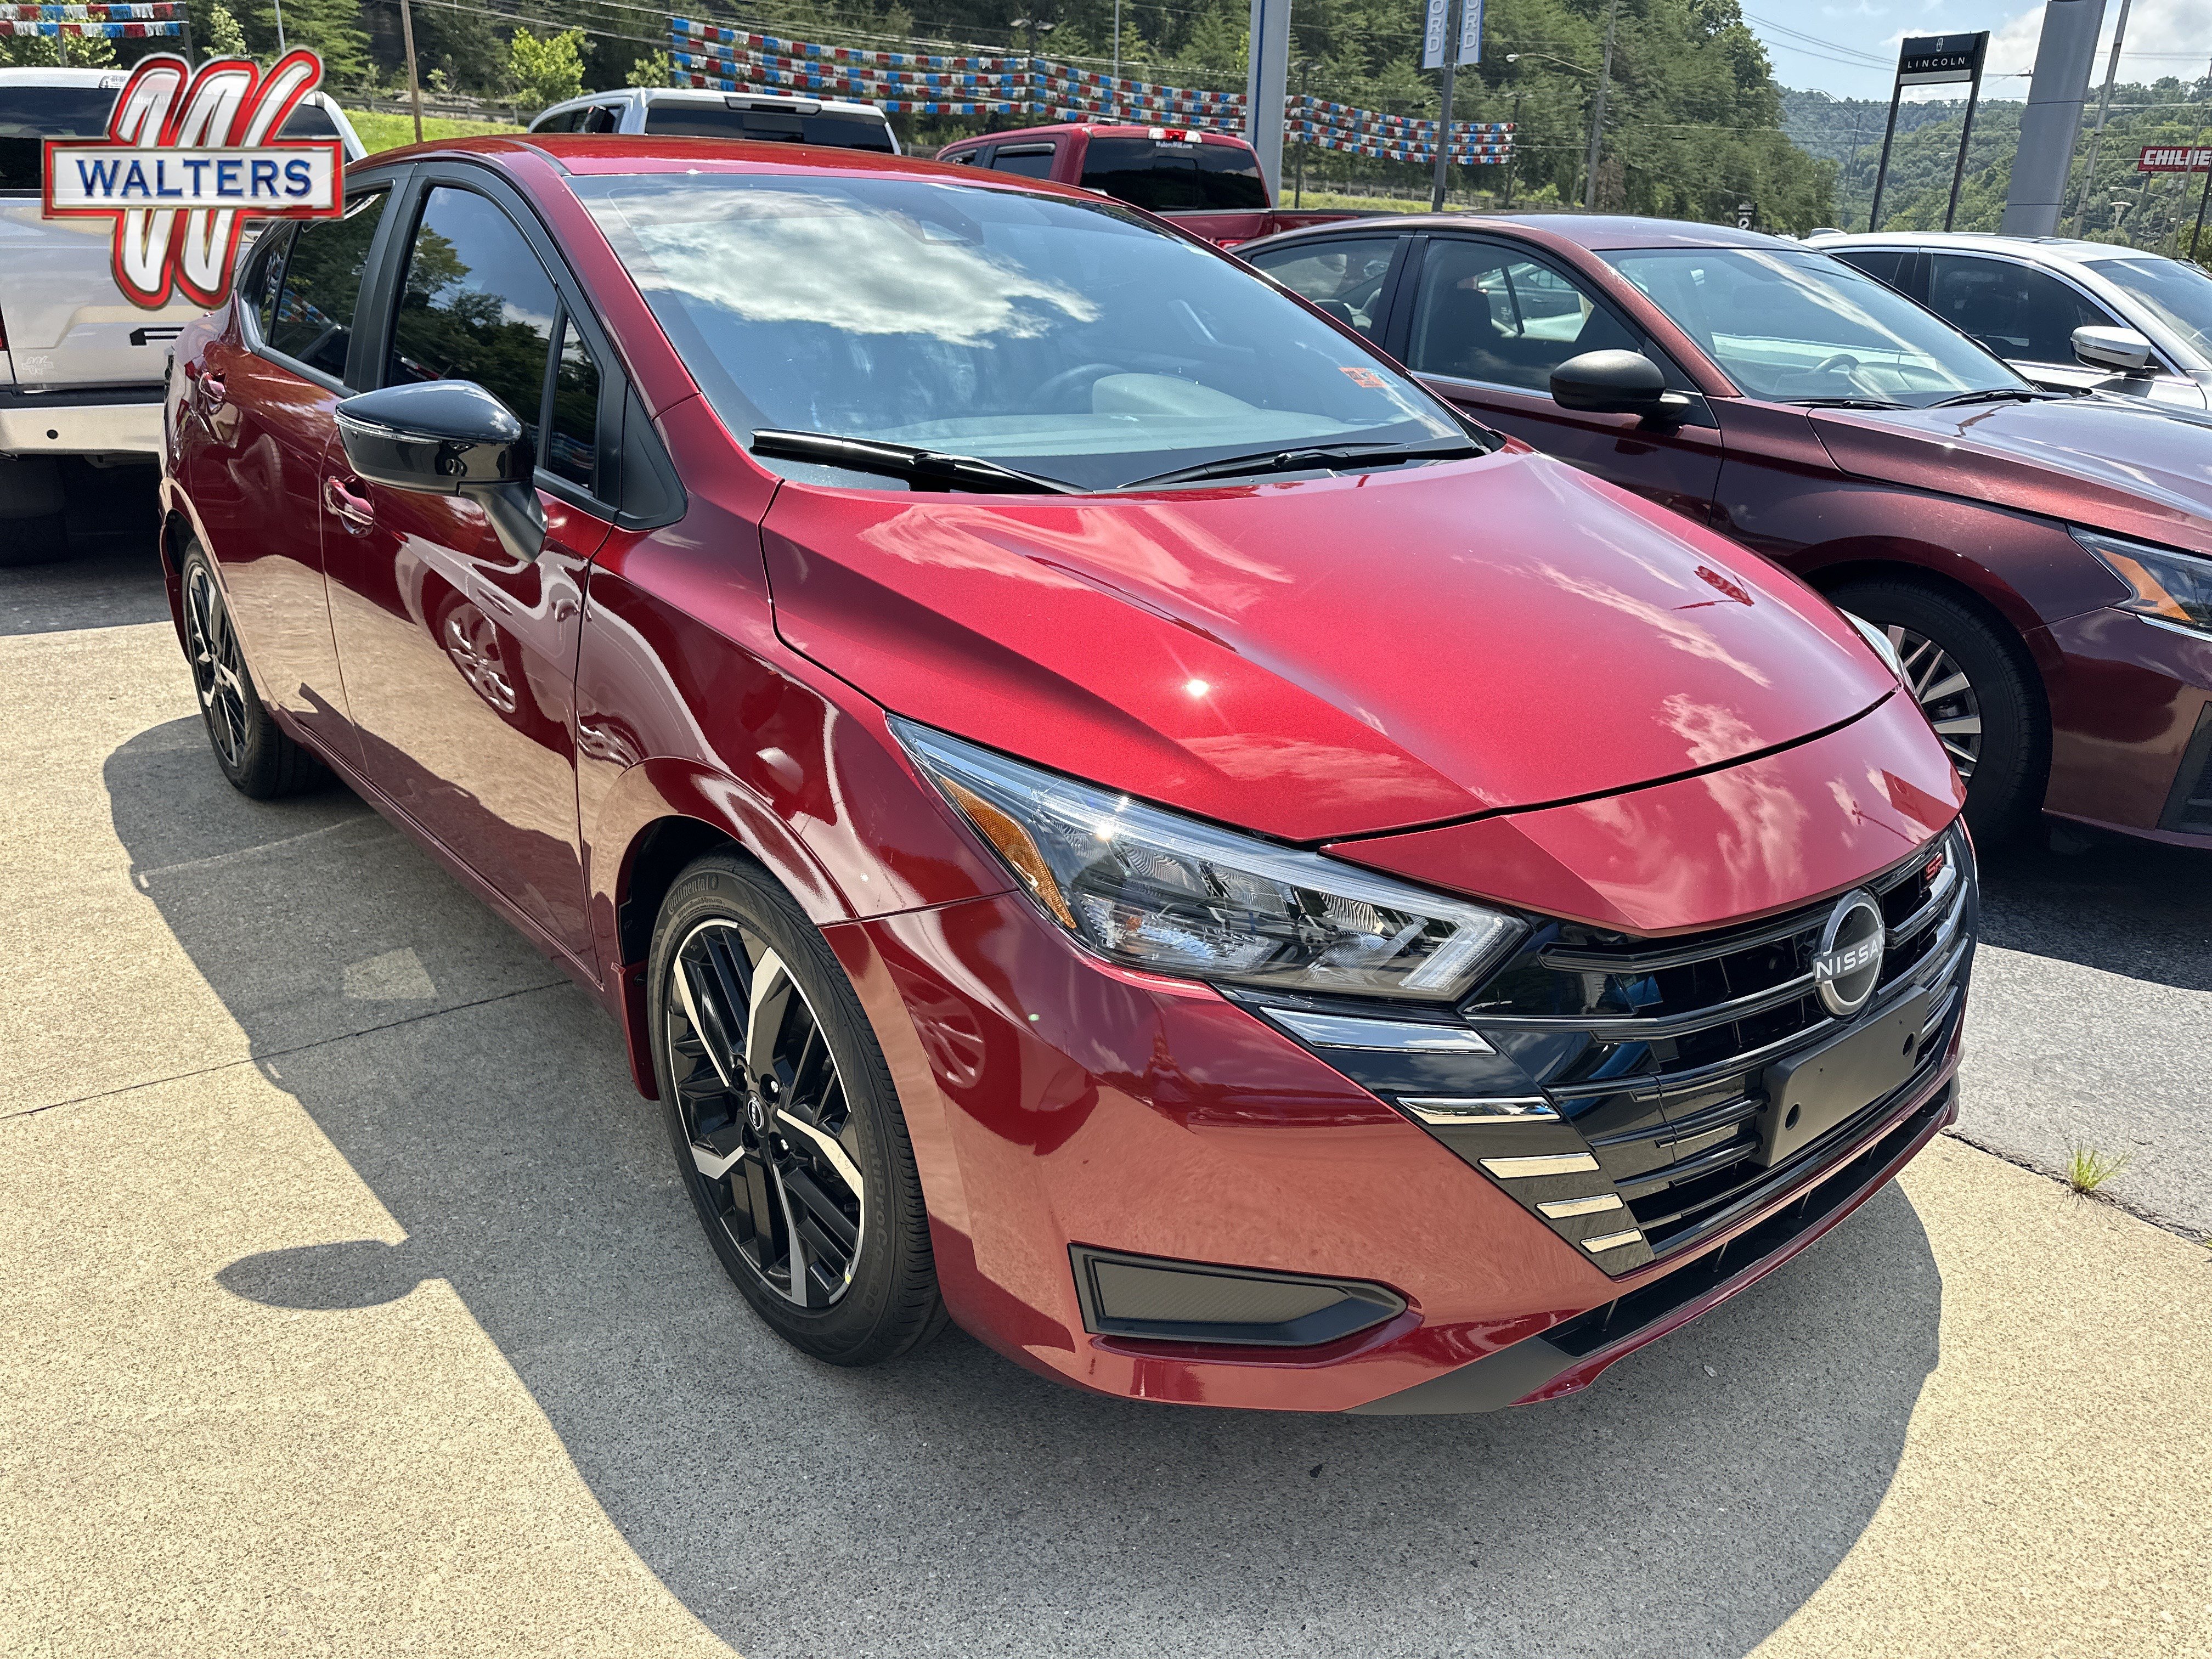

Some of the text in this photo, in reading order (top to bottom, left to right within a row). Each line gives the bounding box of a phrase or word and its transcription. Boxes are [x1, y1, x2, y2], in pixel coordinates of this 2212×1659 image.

[1908, 57, 1965, 68] LINCOLN
[667, 874, 710, 916] Continental
[1816, 933, 1884, 979] NISSAN
